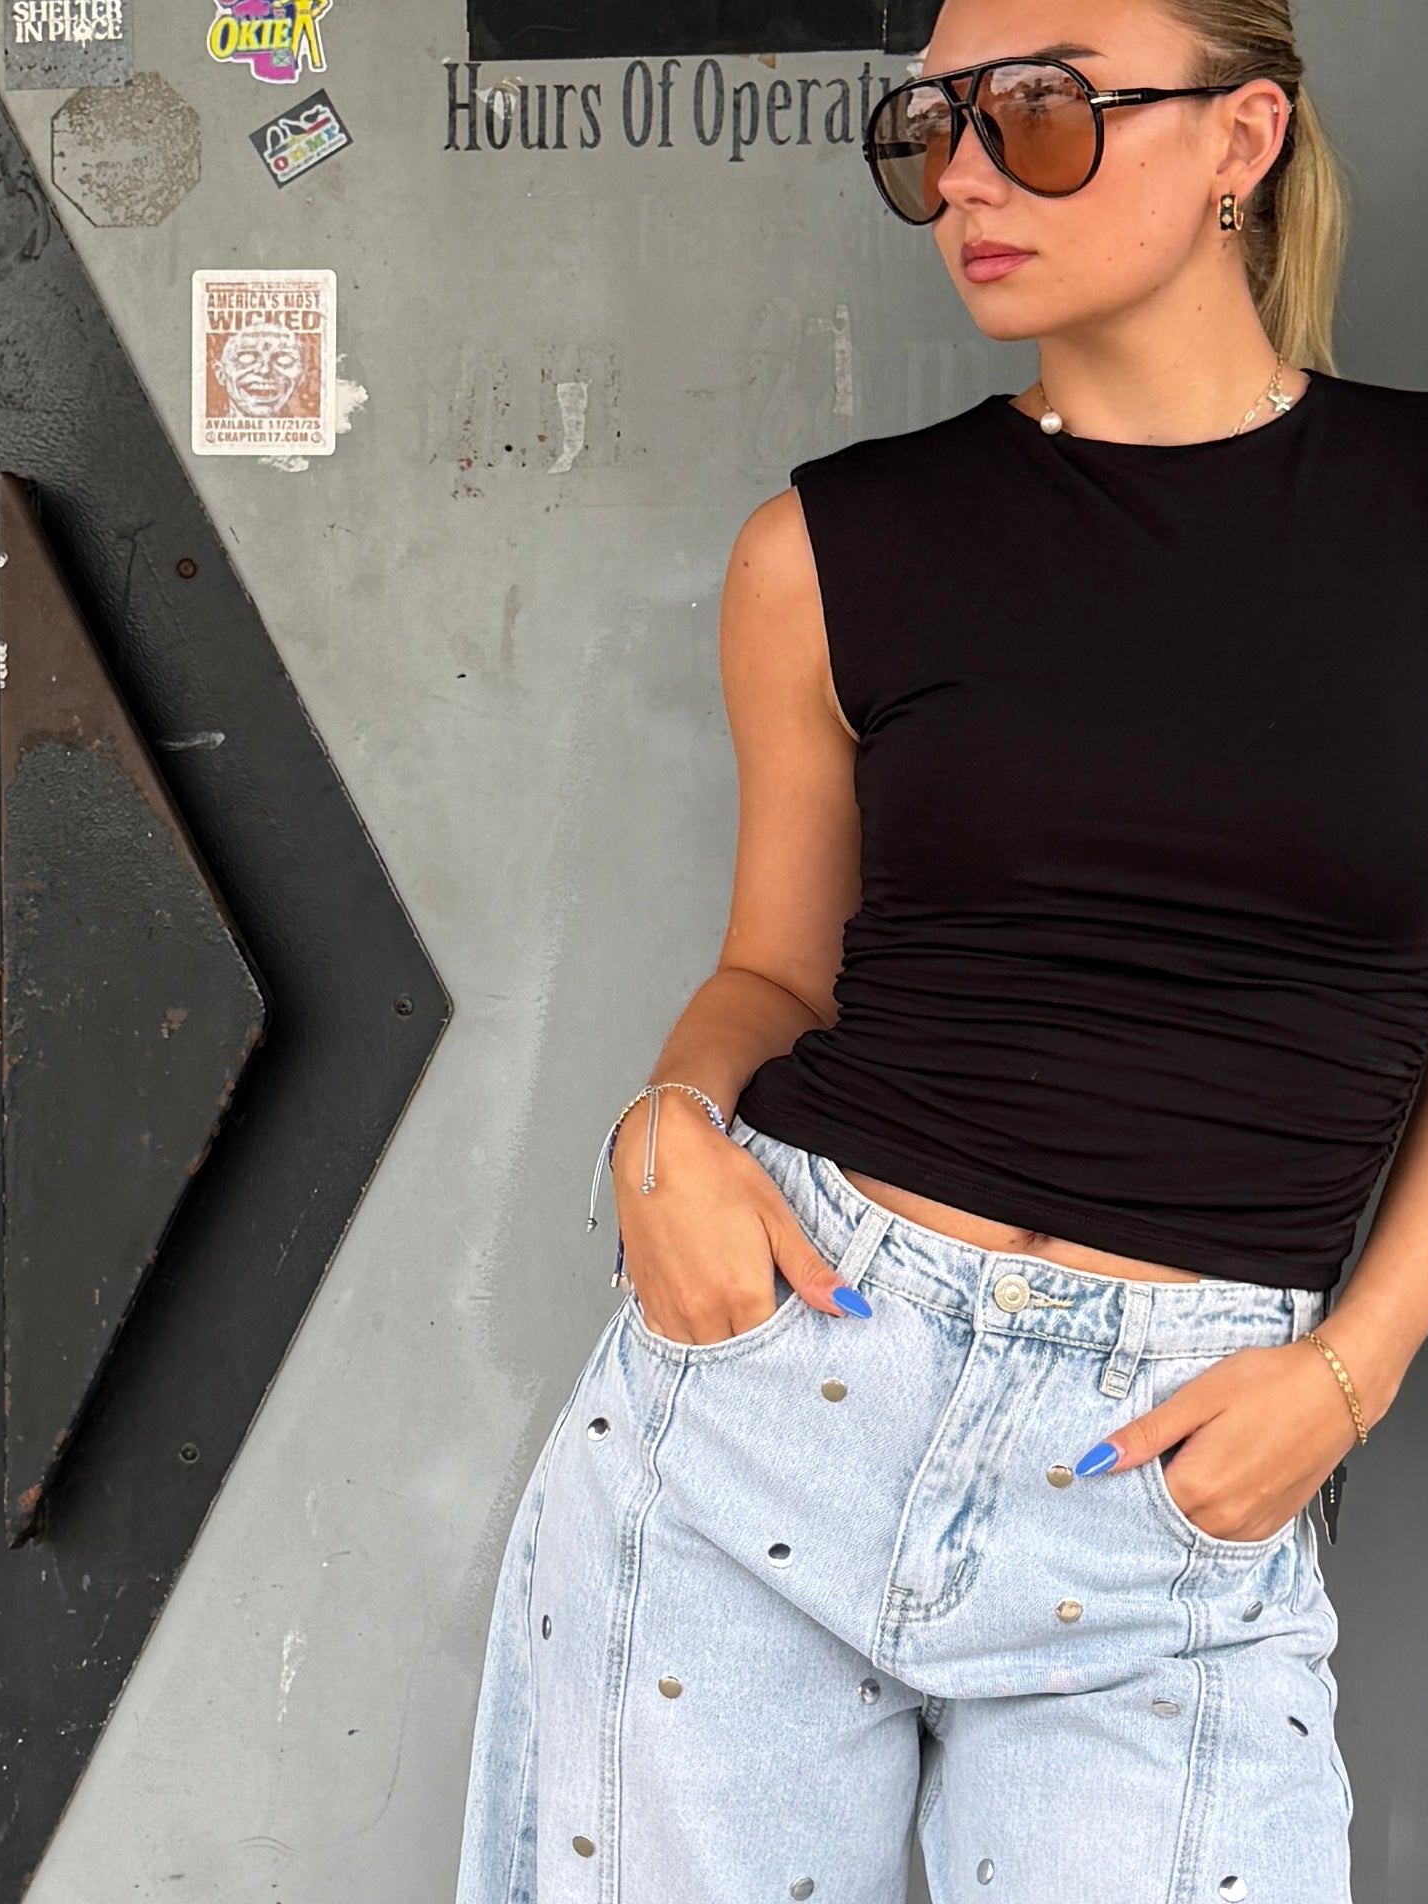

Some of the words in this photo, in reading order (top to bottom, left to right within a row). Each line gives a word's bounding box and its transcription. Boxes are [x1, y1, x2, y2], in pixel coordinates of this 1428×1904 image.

[16, 21, 43, 43] IN
[210, 14, 294, 58] OKIE
[444, 61, 602, 151] Hours
[621, 59, 682, 148] Of
[207, 293, 279, 309] AMERICA'S
[284, 291, 321, 308] MOST
[207, 310, 321, 330] WICKED
[206, 419, 265, 430] AVAILABLE
